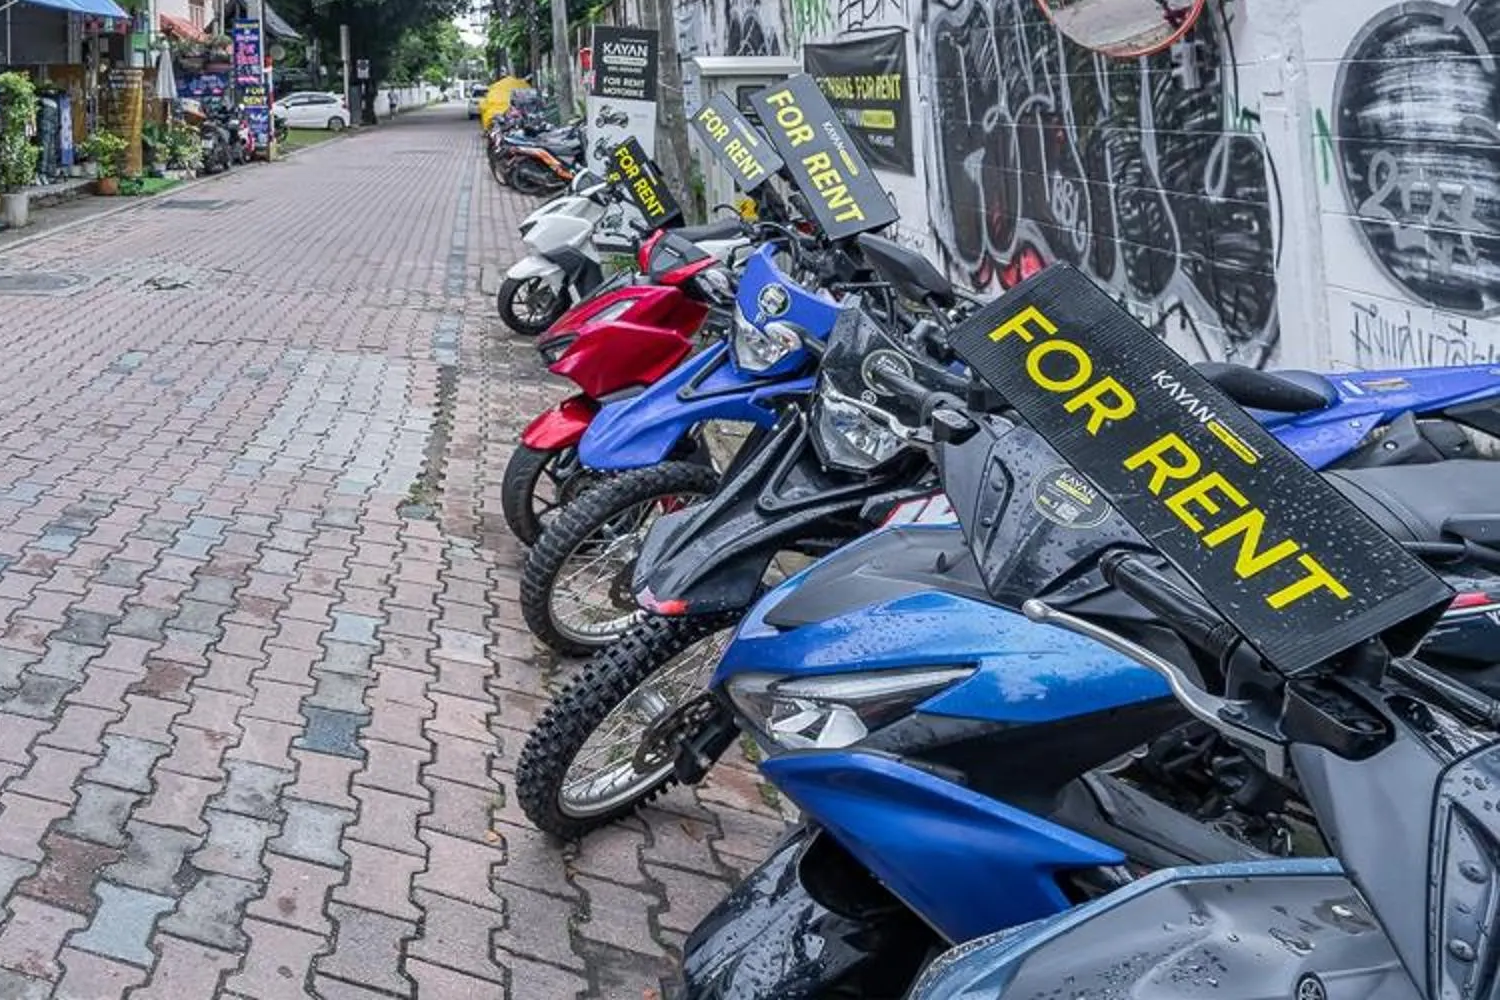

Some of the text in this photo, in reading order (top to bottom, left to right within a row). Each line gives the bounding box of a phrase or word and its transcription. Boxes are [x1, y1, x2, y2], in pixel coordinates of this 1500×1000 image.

[602, 42, 648, 57] KAYAN
[698, 107, 765, 180] FOR RENT
[765, 90, 814, 147] FOR
[802, 151, 865, 222] RENT
[615, 146, 665, 216] FOR RENT
[1151, 369, 1216, 423] KAYAN
[988, 305, 1351, 610] FOR RENT
